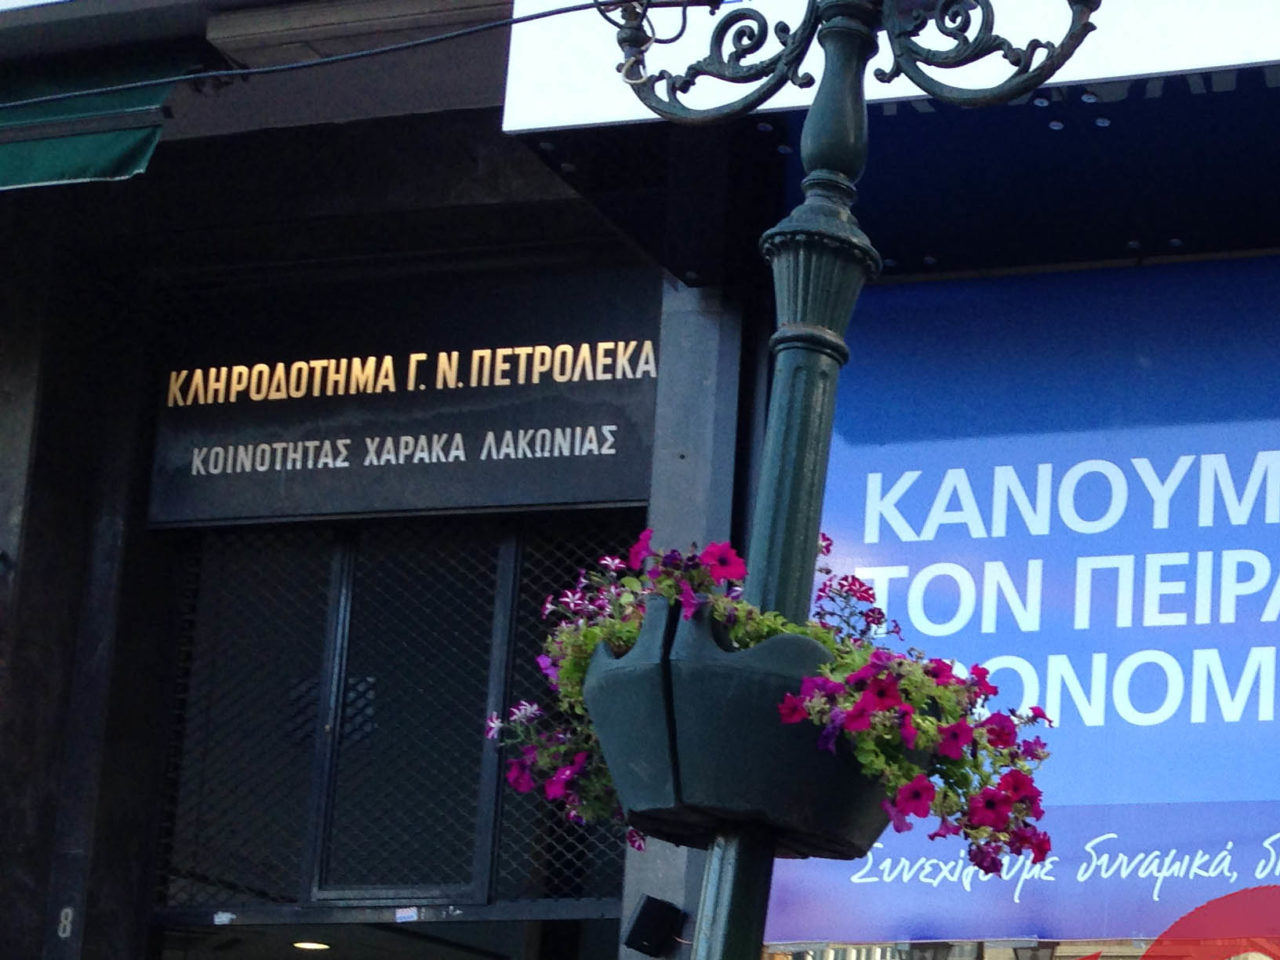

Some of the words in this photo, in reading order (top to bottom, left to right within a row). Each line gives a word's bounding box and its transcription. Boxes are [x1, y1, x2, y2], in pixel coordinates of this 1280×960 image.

[167, 355, 397, 408] ΚΛΗΡΟΔΟΤΗΜΑ
[407, 353, 428, 391] Γ.
[436, 351, 464, 390] Ν.
[469, 340, 658, 388] ΠΕΤΡΟΛΕΚΑ
[191, 438, 352, 476] ΚΟΙΝΟΤΗΤΑΣ
[363, 432, 467, 467] ΧΑΡΑΚΑ
[480, 425, 618, 461] ΛΑΚΩΝΙΑΣ
[854, 558, 1042, 638] ΤΟΝ
[1076, 833, 1239, 902] δυναμικά,
[57, 907, 74, 938] 8
